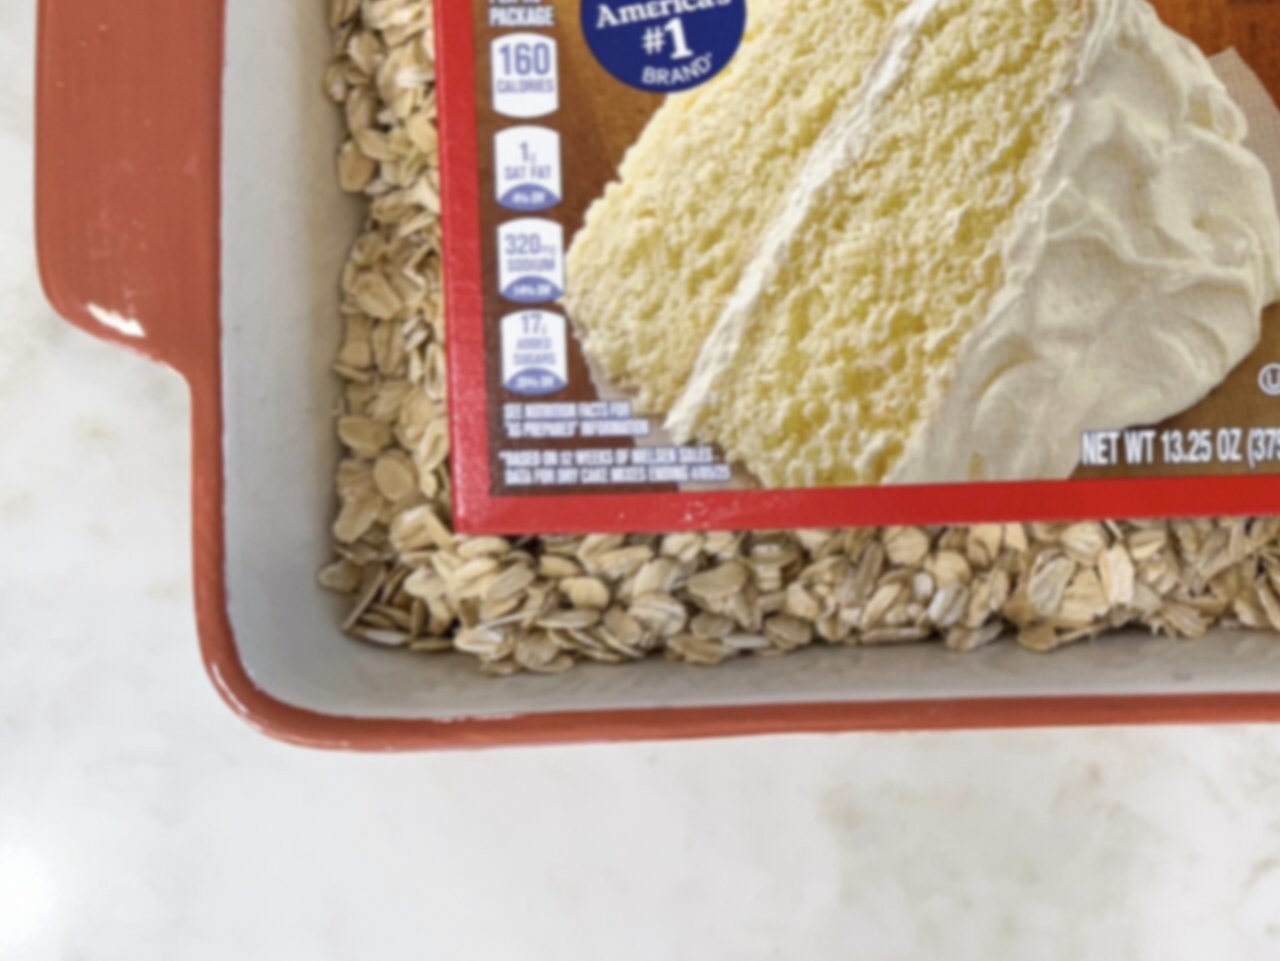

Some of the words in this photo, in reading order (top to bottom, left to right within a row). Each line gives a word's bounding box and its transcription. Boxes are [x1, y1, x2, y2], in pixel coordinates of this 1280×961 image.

[642, 17, 694, 60] #1
[499, 42, 551, 76] 160
[1080, 431, 1119, 466] NET
[1123, 430, 1156, 465] WT
[1161, 429, 1212, 463] 13.25
[1216, 428, 1242, 462] OZ
